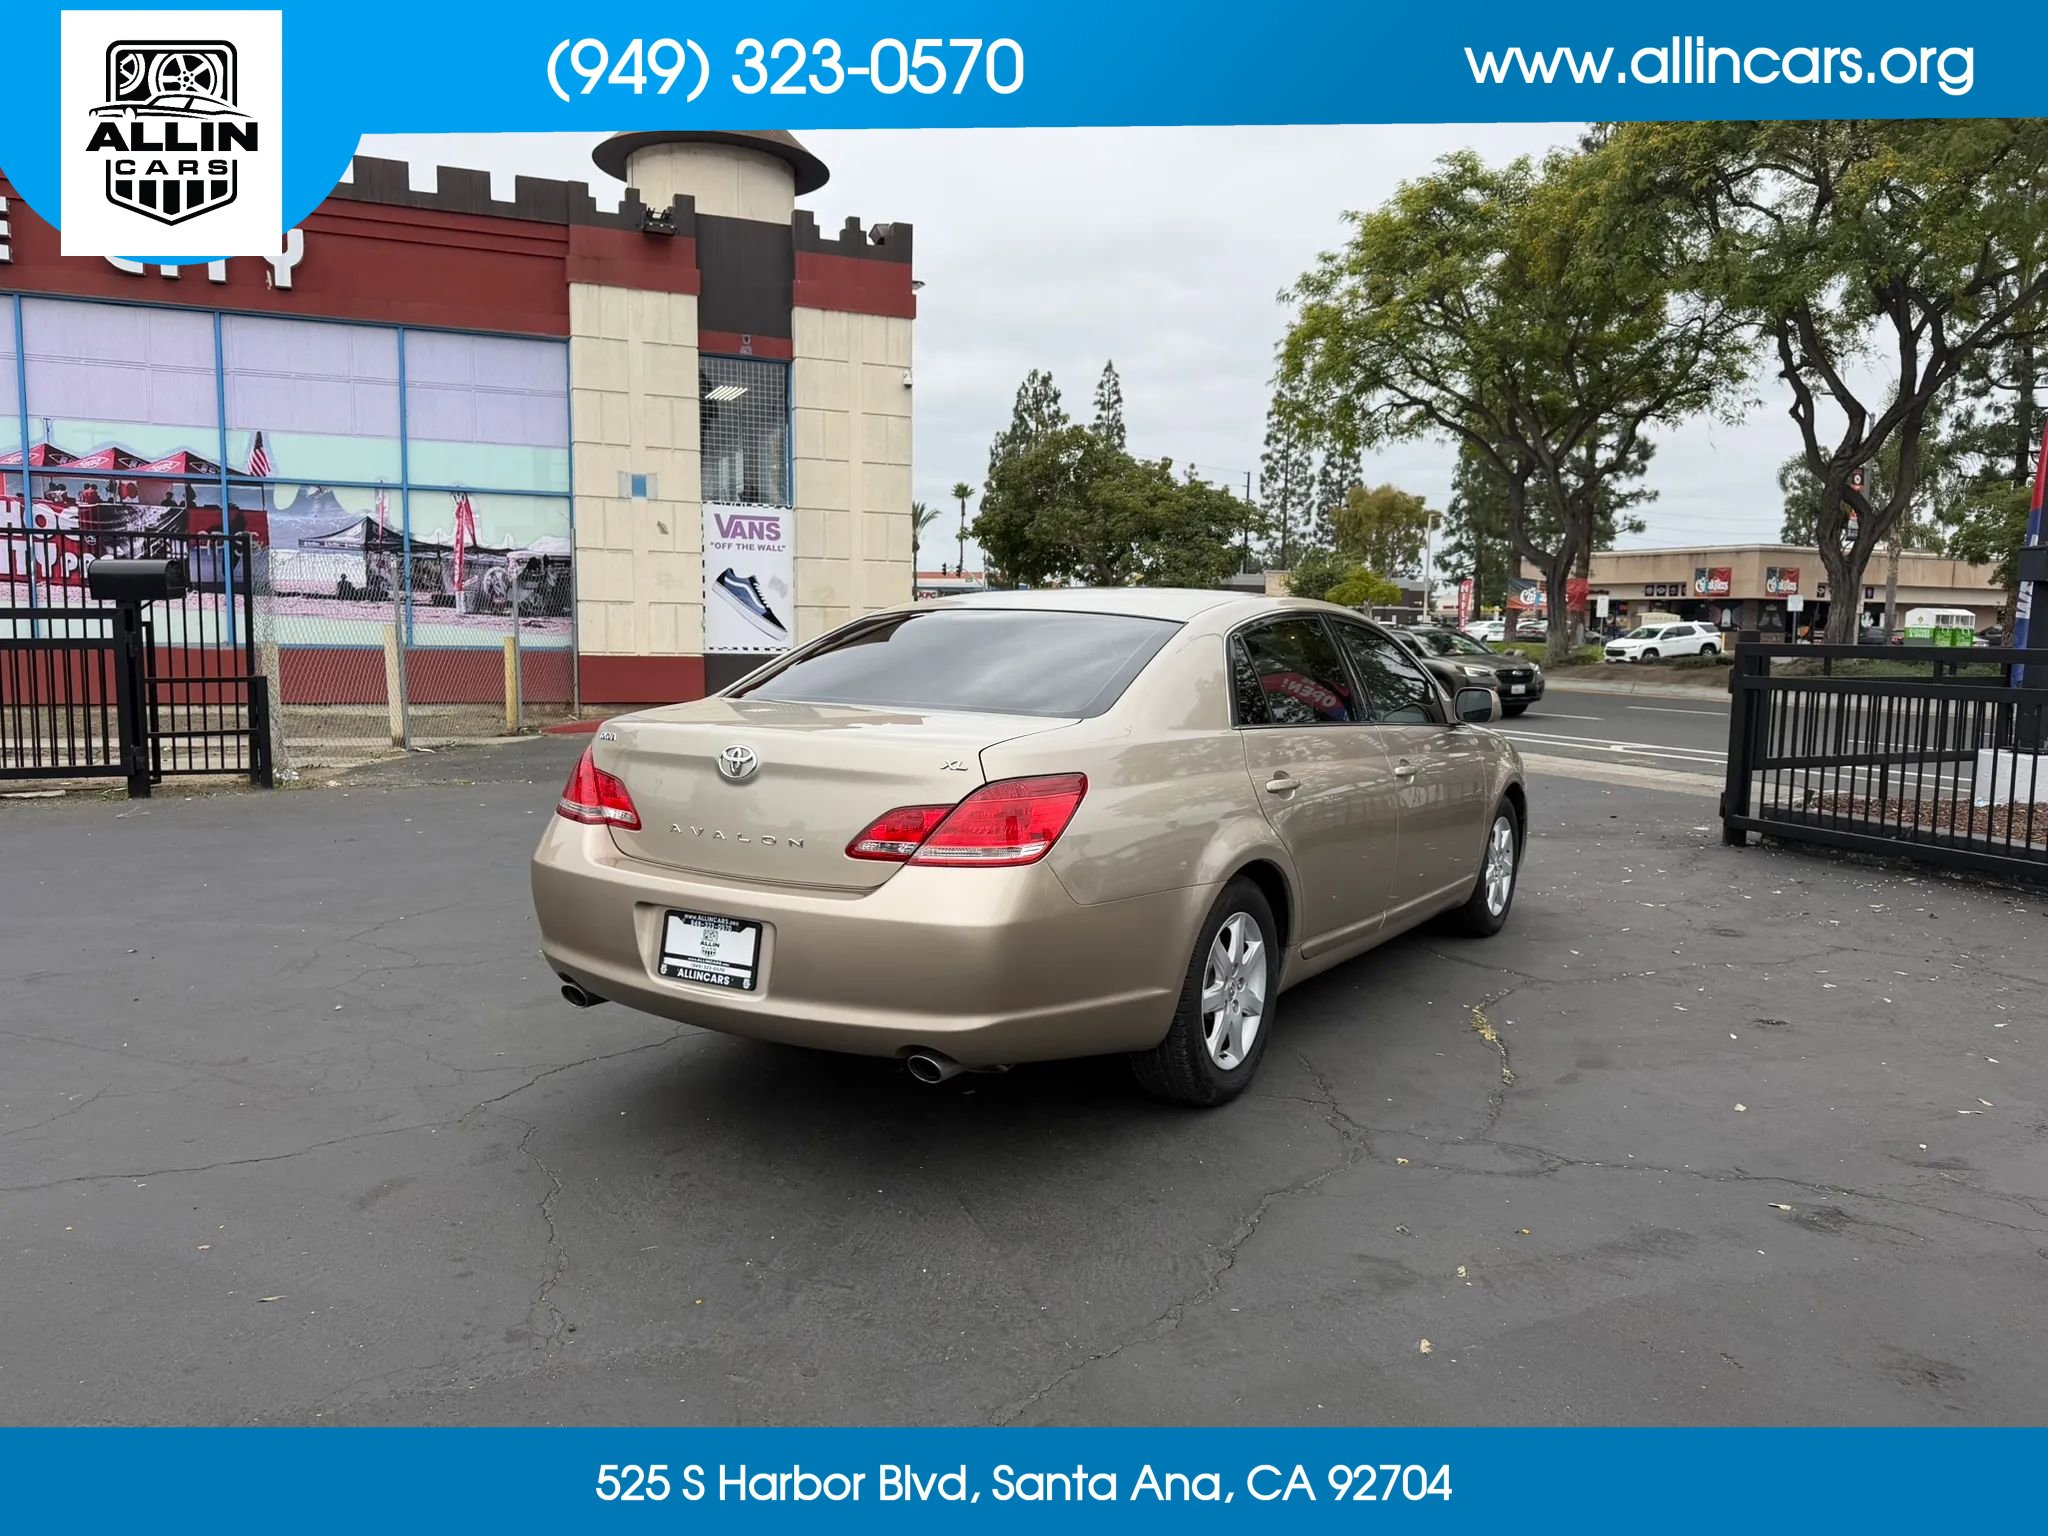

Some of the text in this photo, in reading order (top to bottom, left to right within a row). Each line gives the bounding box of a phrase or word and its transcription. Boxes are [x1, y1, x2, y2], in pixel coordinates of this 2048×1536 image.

[714, 513, 781, 541] VANS
[736, 543, 755, 551] THE
[919, 591, 937, 599] KFC
[940, 759, 969, 771] XL
[669, 823, 804, 848] AVALON
[677, 967, 730, 986] ALLINCARS
